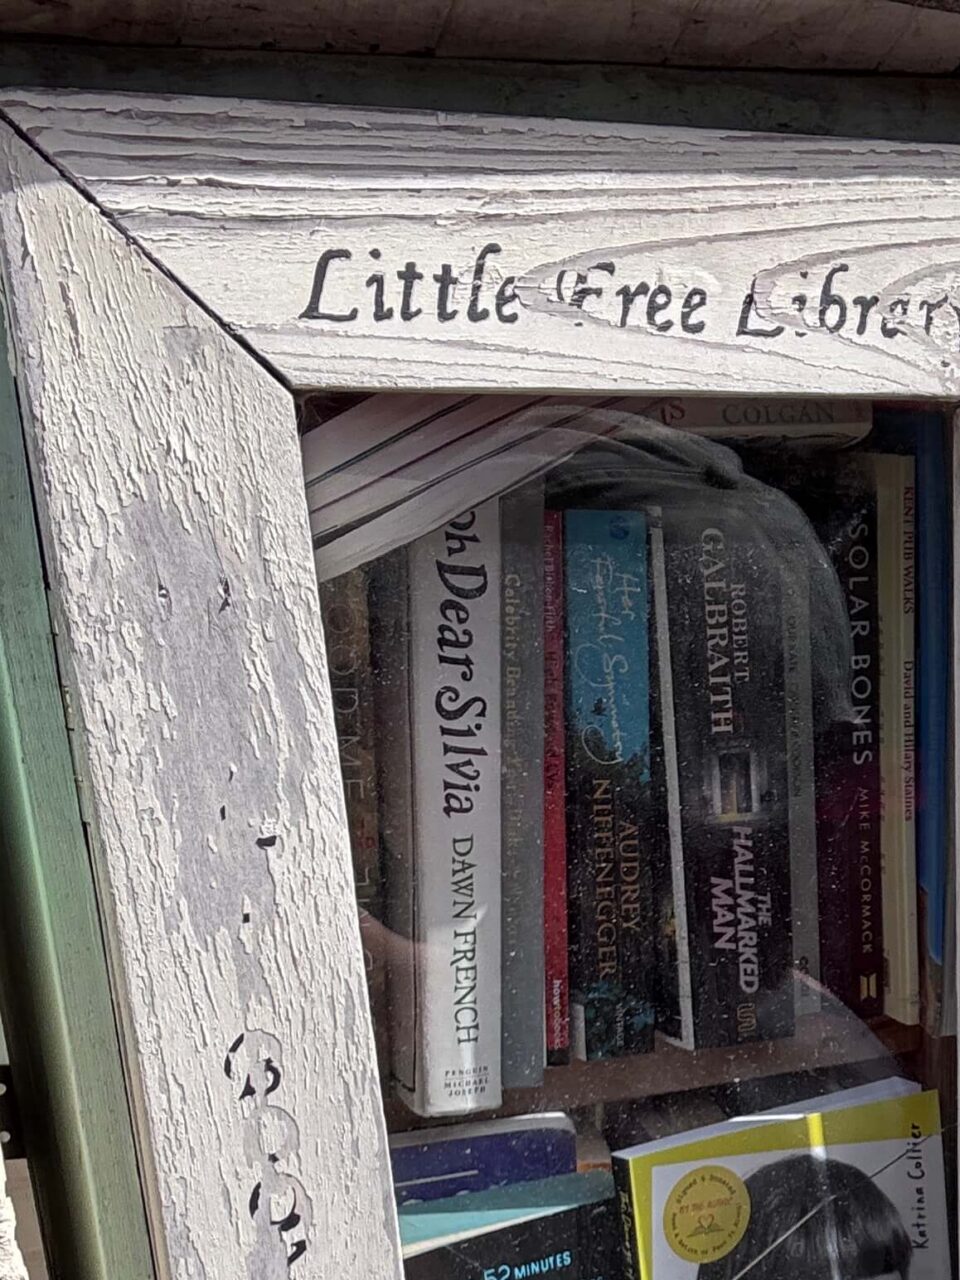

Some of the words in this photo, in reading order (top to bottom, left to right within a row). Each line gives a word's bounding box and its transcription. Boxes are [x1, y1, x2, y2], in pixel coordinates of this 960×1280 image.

[301, 242, 519, 325] Little
[722, 402, 836, 425] COLGAN
[850, 522, 871, 637] SOLAR
[903, 530, 914, 561] PUB
[436, 559, 489, 682] Dear
[701, 527, 733, 734] GALBRAITH
[903, 563, 914, 614] WALKS
[328, 604, 359, 713] OOD
[730, 583, 750, 684] ROBERT
[851, 654, 872, 765] BONES
[903, 660, 914, 699] David
[903, 703, 914, 727] and
[434, 685, 489, 819] Silvia
[857, 787, 870, 830] MIKE
[903, 775, 914, 822] Staines
[452, 834, 478, 921] DAWN
[593, 778, 618, 978] NIFFENEGGER
[620, 820, 641, 932] AUDREY
[710, 876, 736, 950] MAN
[731, 826, 759, 994] HALLMARKED
[755, 892, 772, 926] THE
[450, 929, 480, 1044] FRENCH
[910, 1187, 930, 1250] Katrina
[514, 1250, 573, 1280] MINUTES
